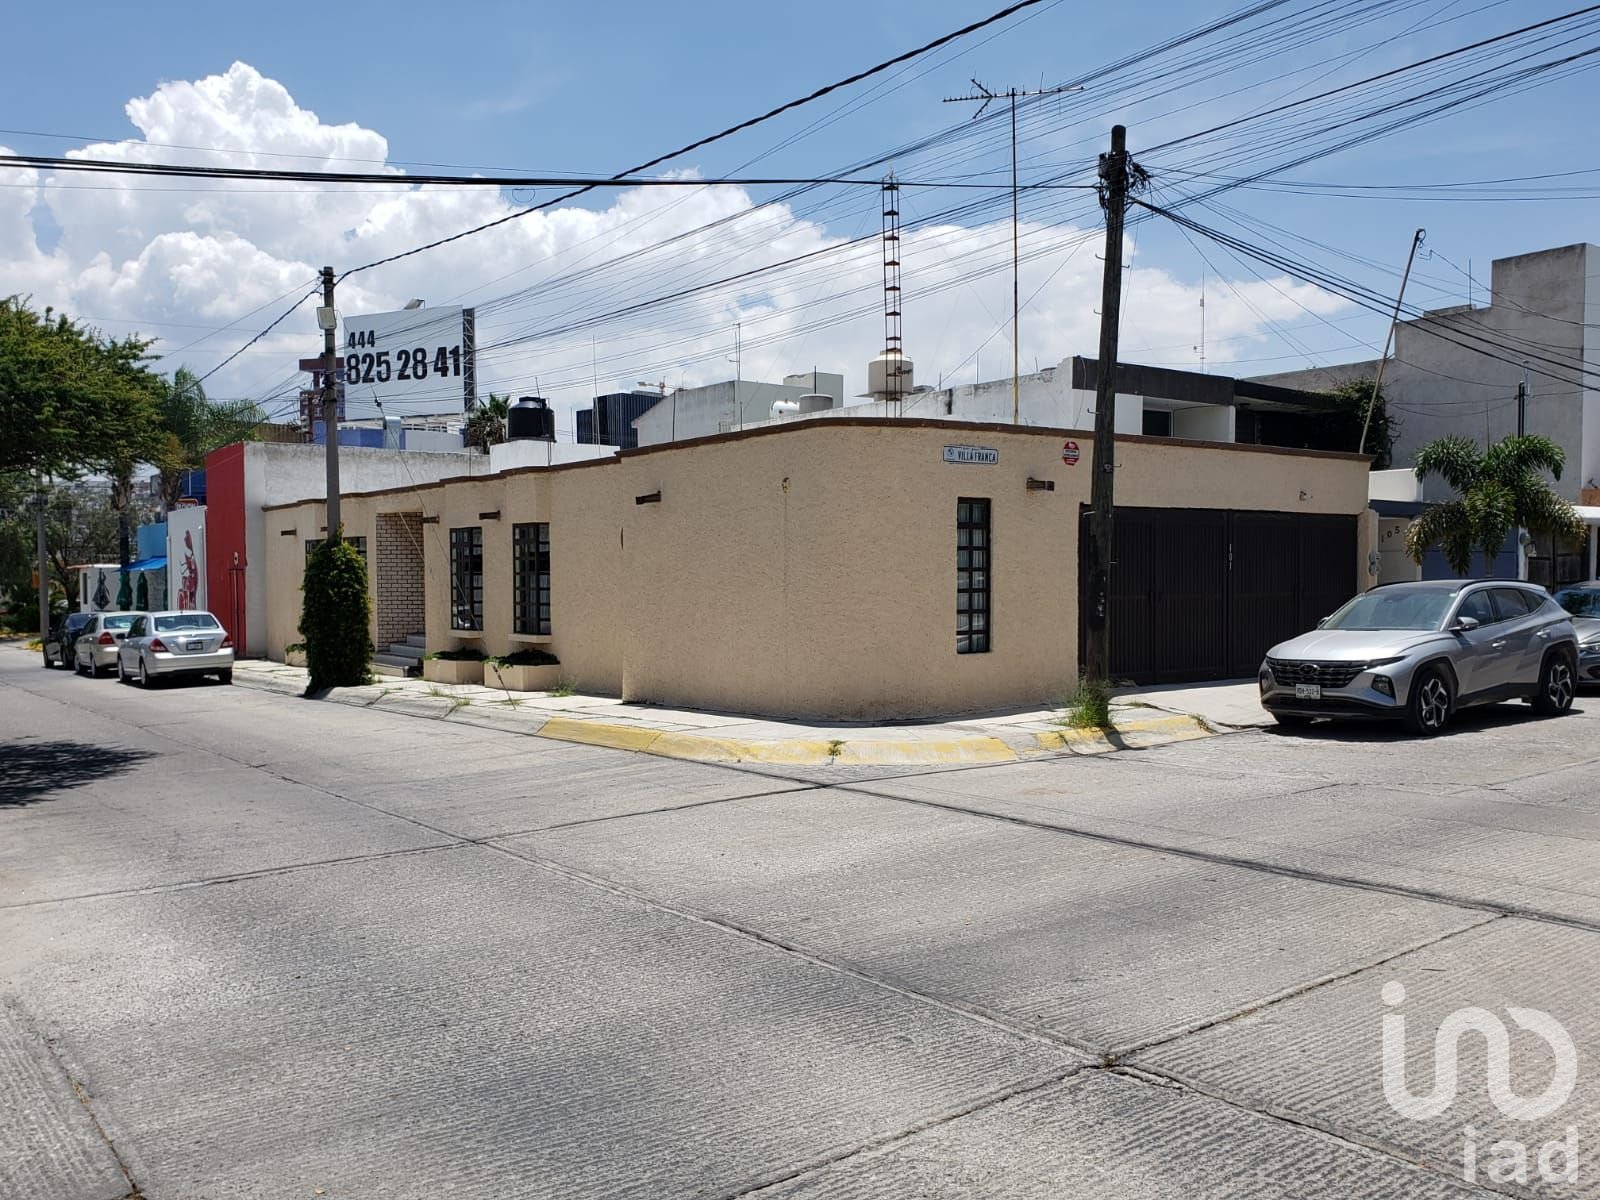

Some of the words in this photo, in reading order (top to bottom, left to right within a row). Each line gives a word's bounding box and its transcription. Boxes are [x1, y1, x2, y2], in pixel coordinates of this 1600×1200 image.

[348, 330, 375, 349] 444
[346, 351, 391, 385] 825
[397, 348, 427, 380] 28
[433, 345, 460, 377] 41
[1381, 525, 1400, 543] 105
